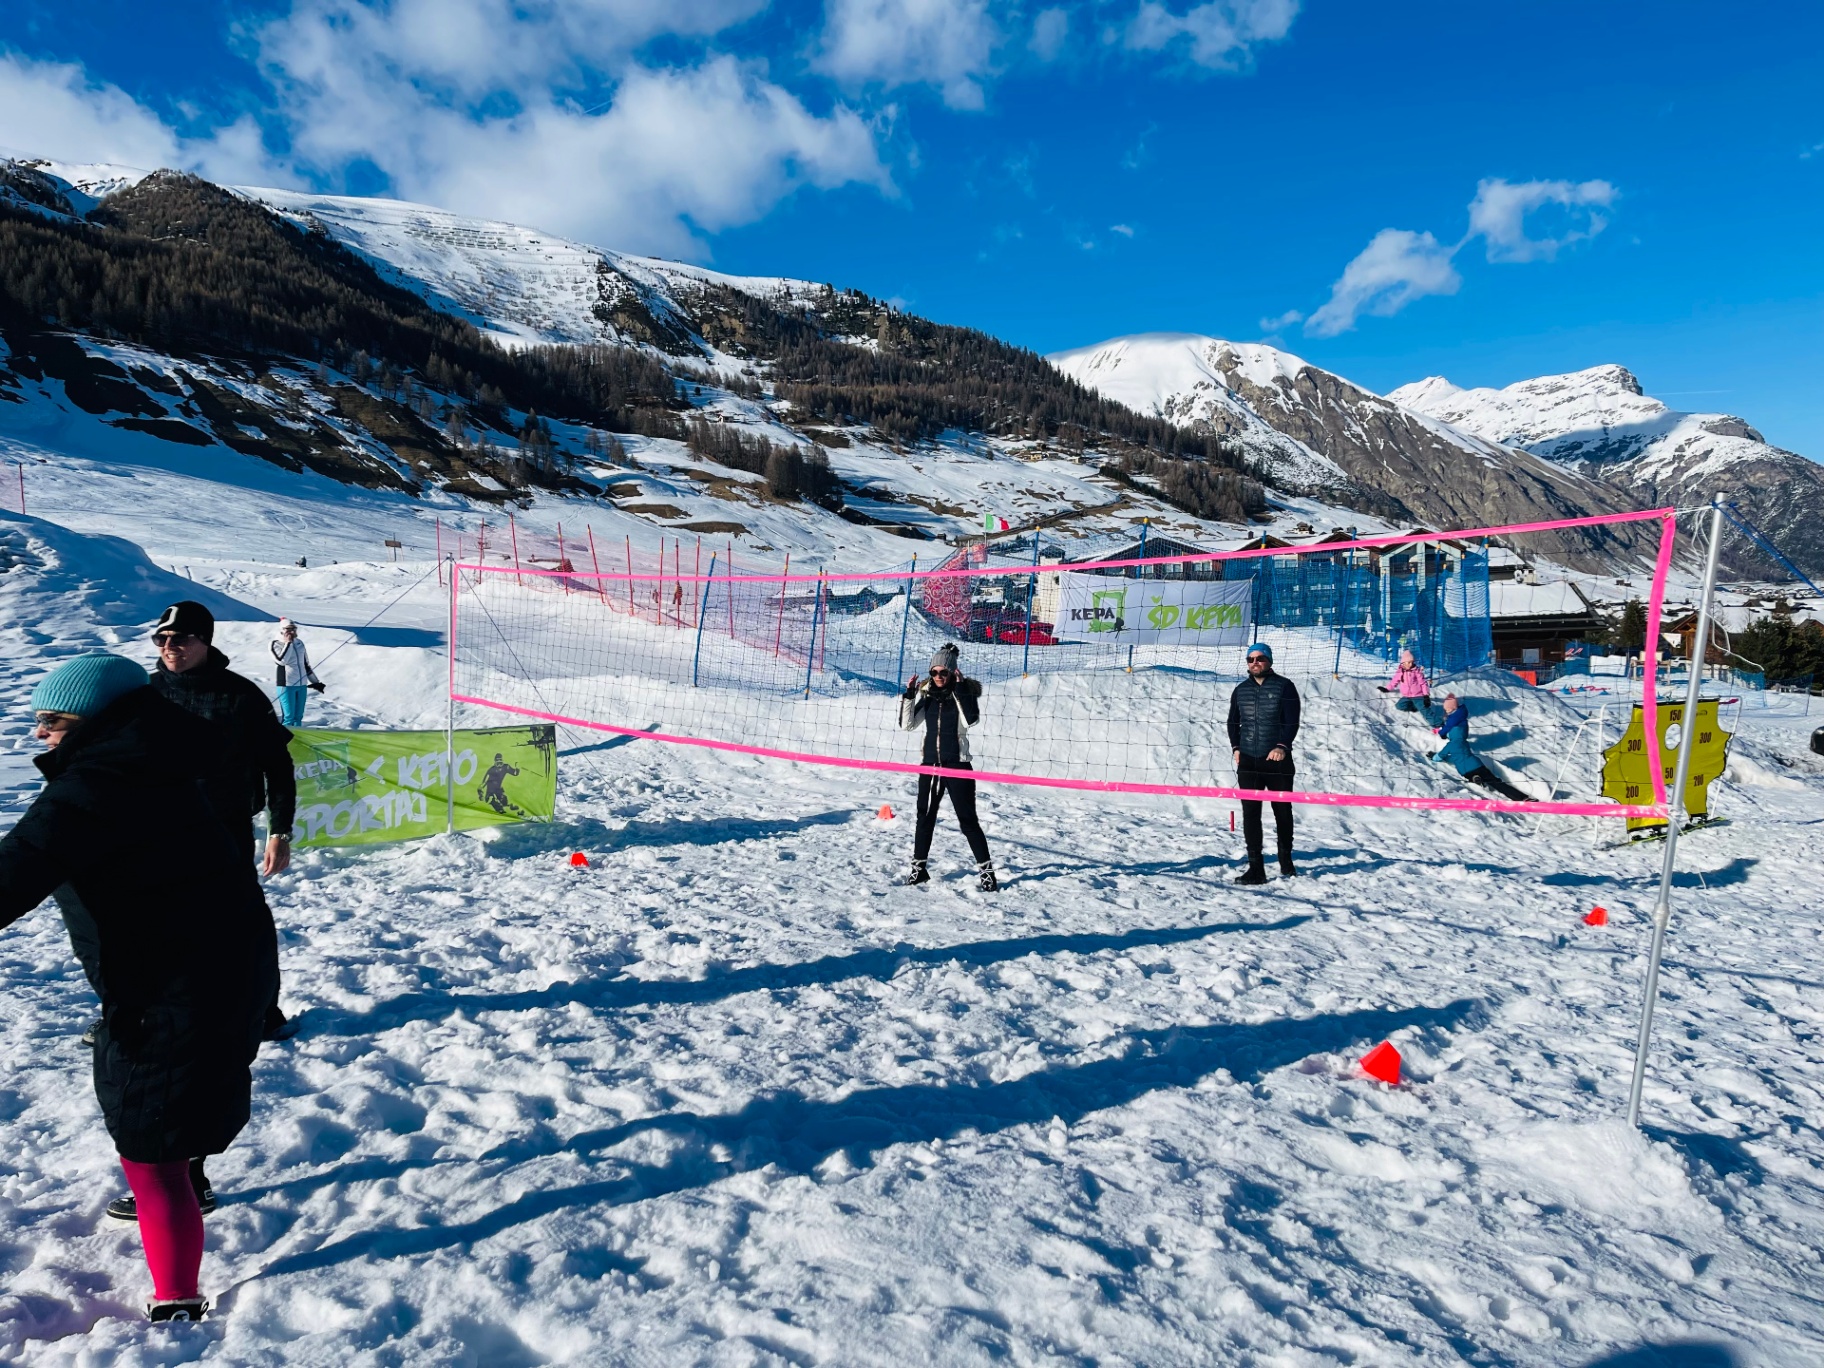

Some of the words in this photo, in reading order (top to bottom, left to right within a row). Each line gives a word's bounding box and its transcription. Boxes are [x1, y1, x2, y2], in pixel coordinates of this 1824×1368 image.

[1071, 607, 1115, 620] KEPA
[1147, 595, 1180, 630] ŠD
[1185, 603, 1242, 631] KEPA
[1669, 709, 1682, 721] 150
[1699, 732, 1712, 744] 300
[1627, 739, 1642, 751] 300
[294, 759, 345, 781] KEPA
[1664, 767, 1674, 779] 50
[1693, 774, 1704, 786] 200
[1625, 785, 1639, 798] 200
